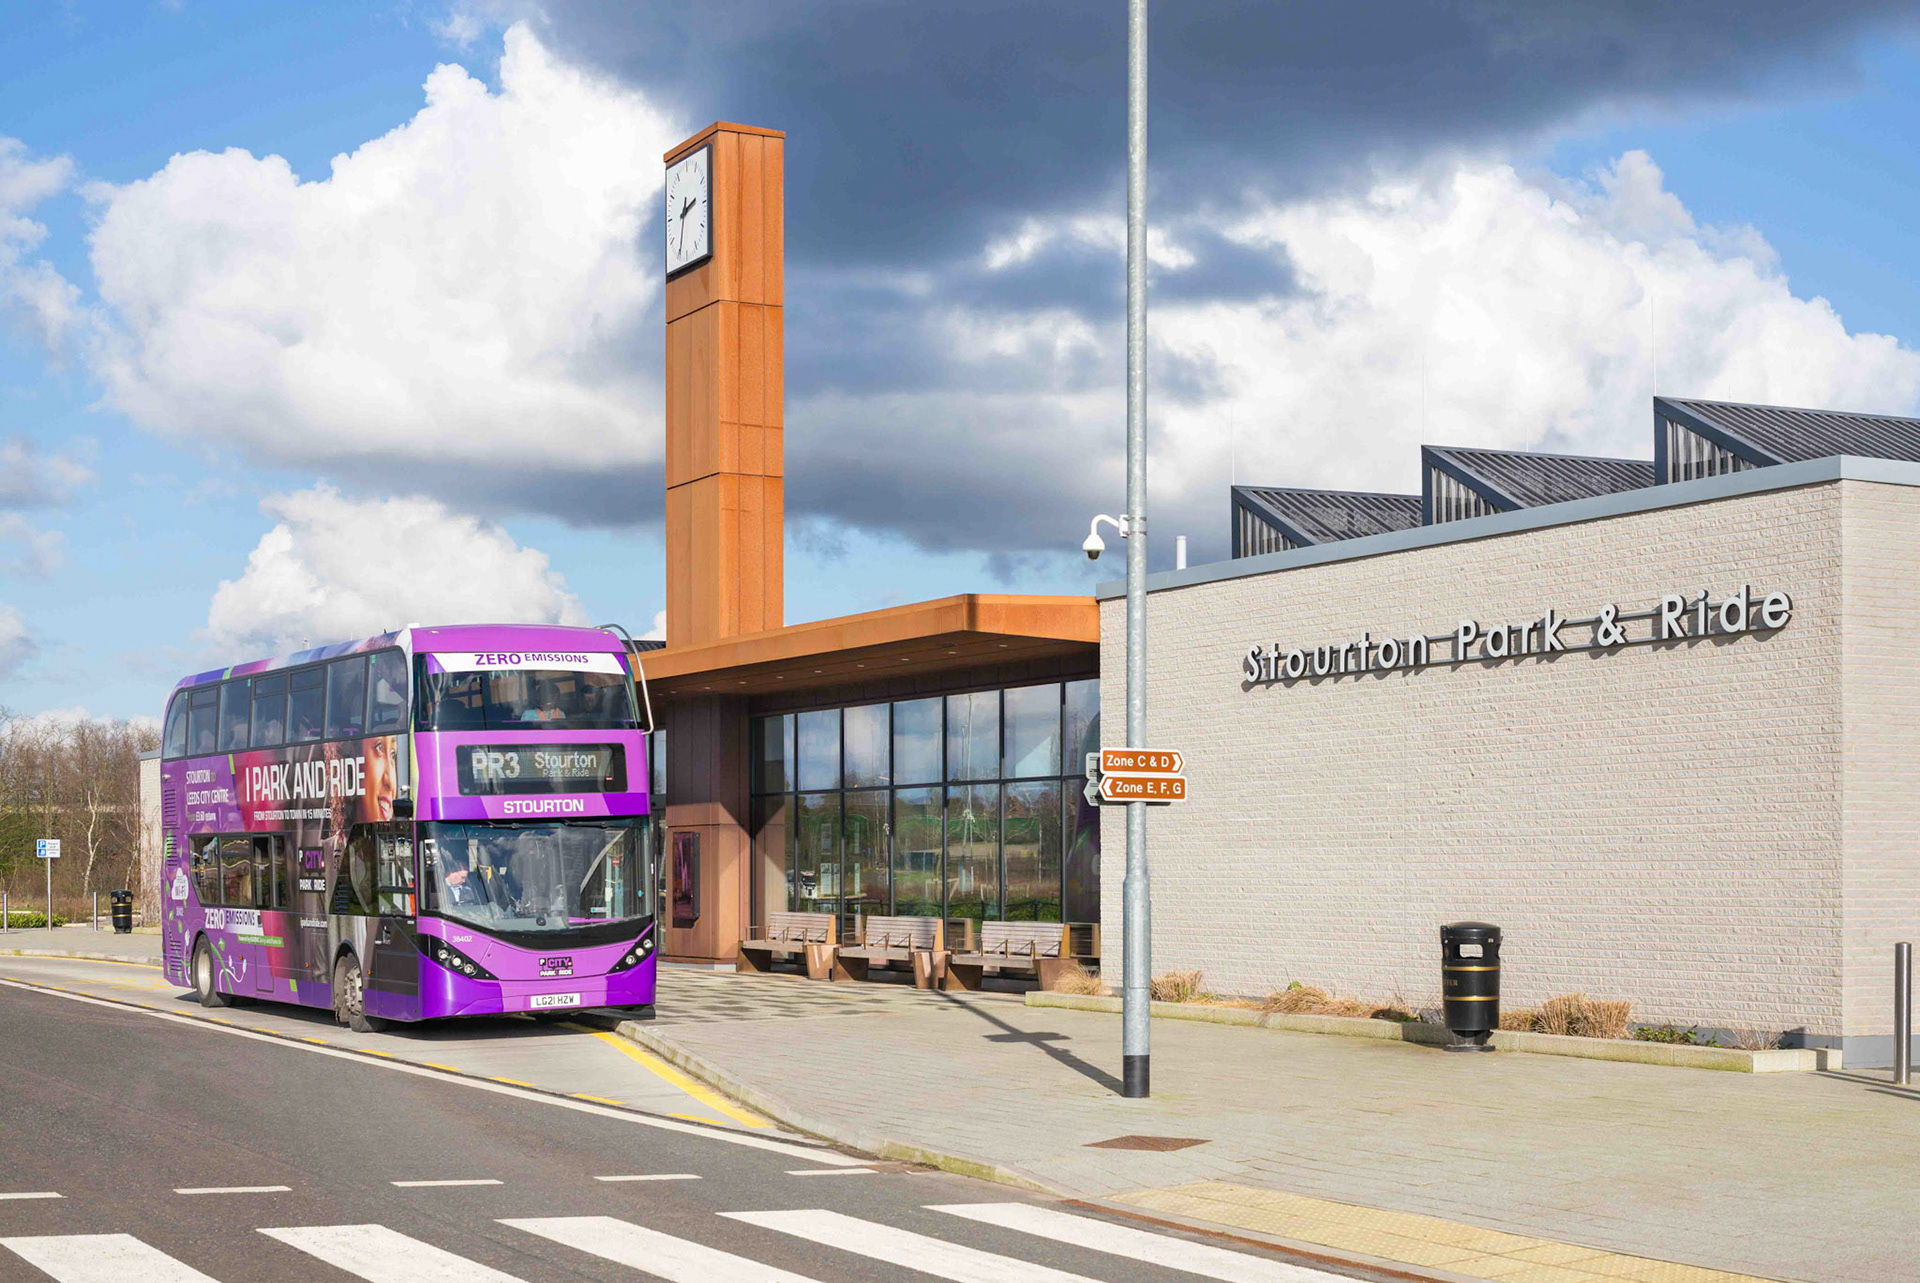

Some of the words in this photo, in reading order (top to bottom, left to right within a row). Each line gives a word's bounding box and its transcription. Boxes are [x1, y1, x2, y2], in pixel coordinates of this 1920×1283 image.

[1244, 632, 1430, 684] Stourton
[1457, 609, 1567, 662] Park
[1596, 603, 1626, 648] &
[1660, 584, 1793, 640] Ride
[474, 653, 521, 666] ZERO
[524, 652, 589, 664] EMISSIONS
[471, 752, 521, 779] PR3
[534, 750, 597, 769] Stourton
[1106, 754, 1134, 767] Zone
[1137, 755, 1146, 768] C
[1149, 757, 1157, 767] &
[1161, 757, 1169, 768] D
[186, 769, 211, 784] STOURTON
[252, 763, 291, 802] PARK
[293, 760, 326, 799] AND
[330, 756, 366, 797] RIDE
[572, 767, 590, 778] Ride
[1115, 781, 1143, 794] Zone
[1147, 782, 1157, 795] E,
[1160, 782, 1170, 795] F,
[1172, 782, 1182, 794] G
[186, 791, 200, 805] LEEDS
[200, 790, 211, 804] CITY
[211, 788, 230, 803] CENTRE
[503, 799, 584, 814] STOURTON
[299, 878, 312, 891] PARK
[313, 878, 326, 891] RIDE
[204, 908, 225, 930] ZERO
[226, 910, 255, 926] EMISSIONS
[536, 996, 556, 1006] LG21
[557, 995, 574, 1005] HZW
